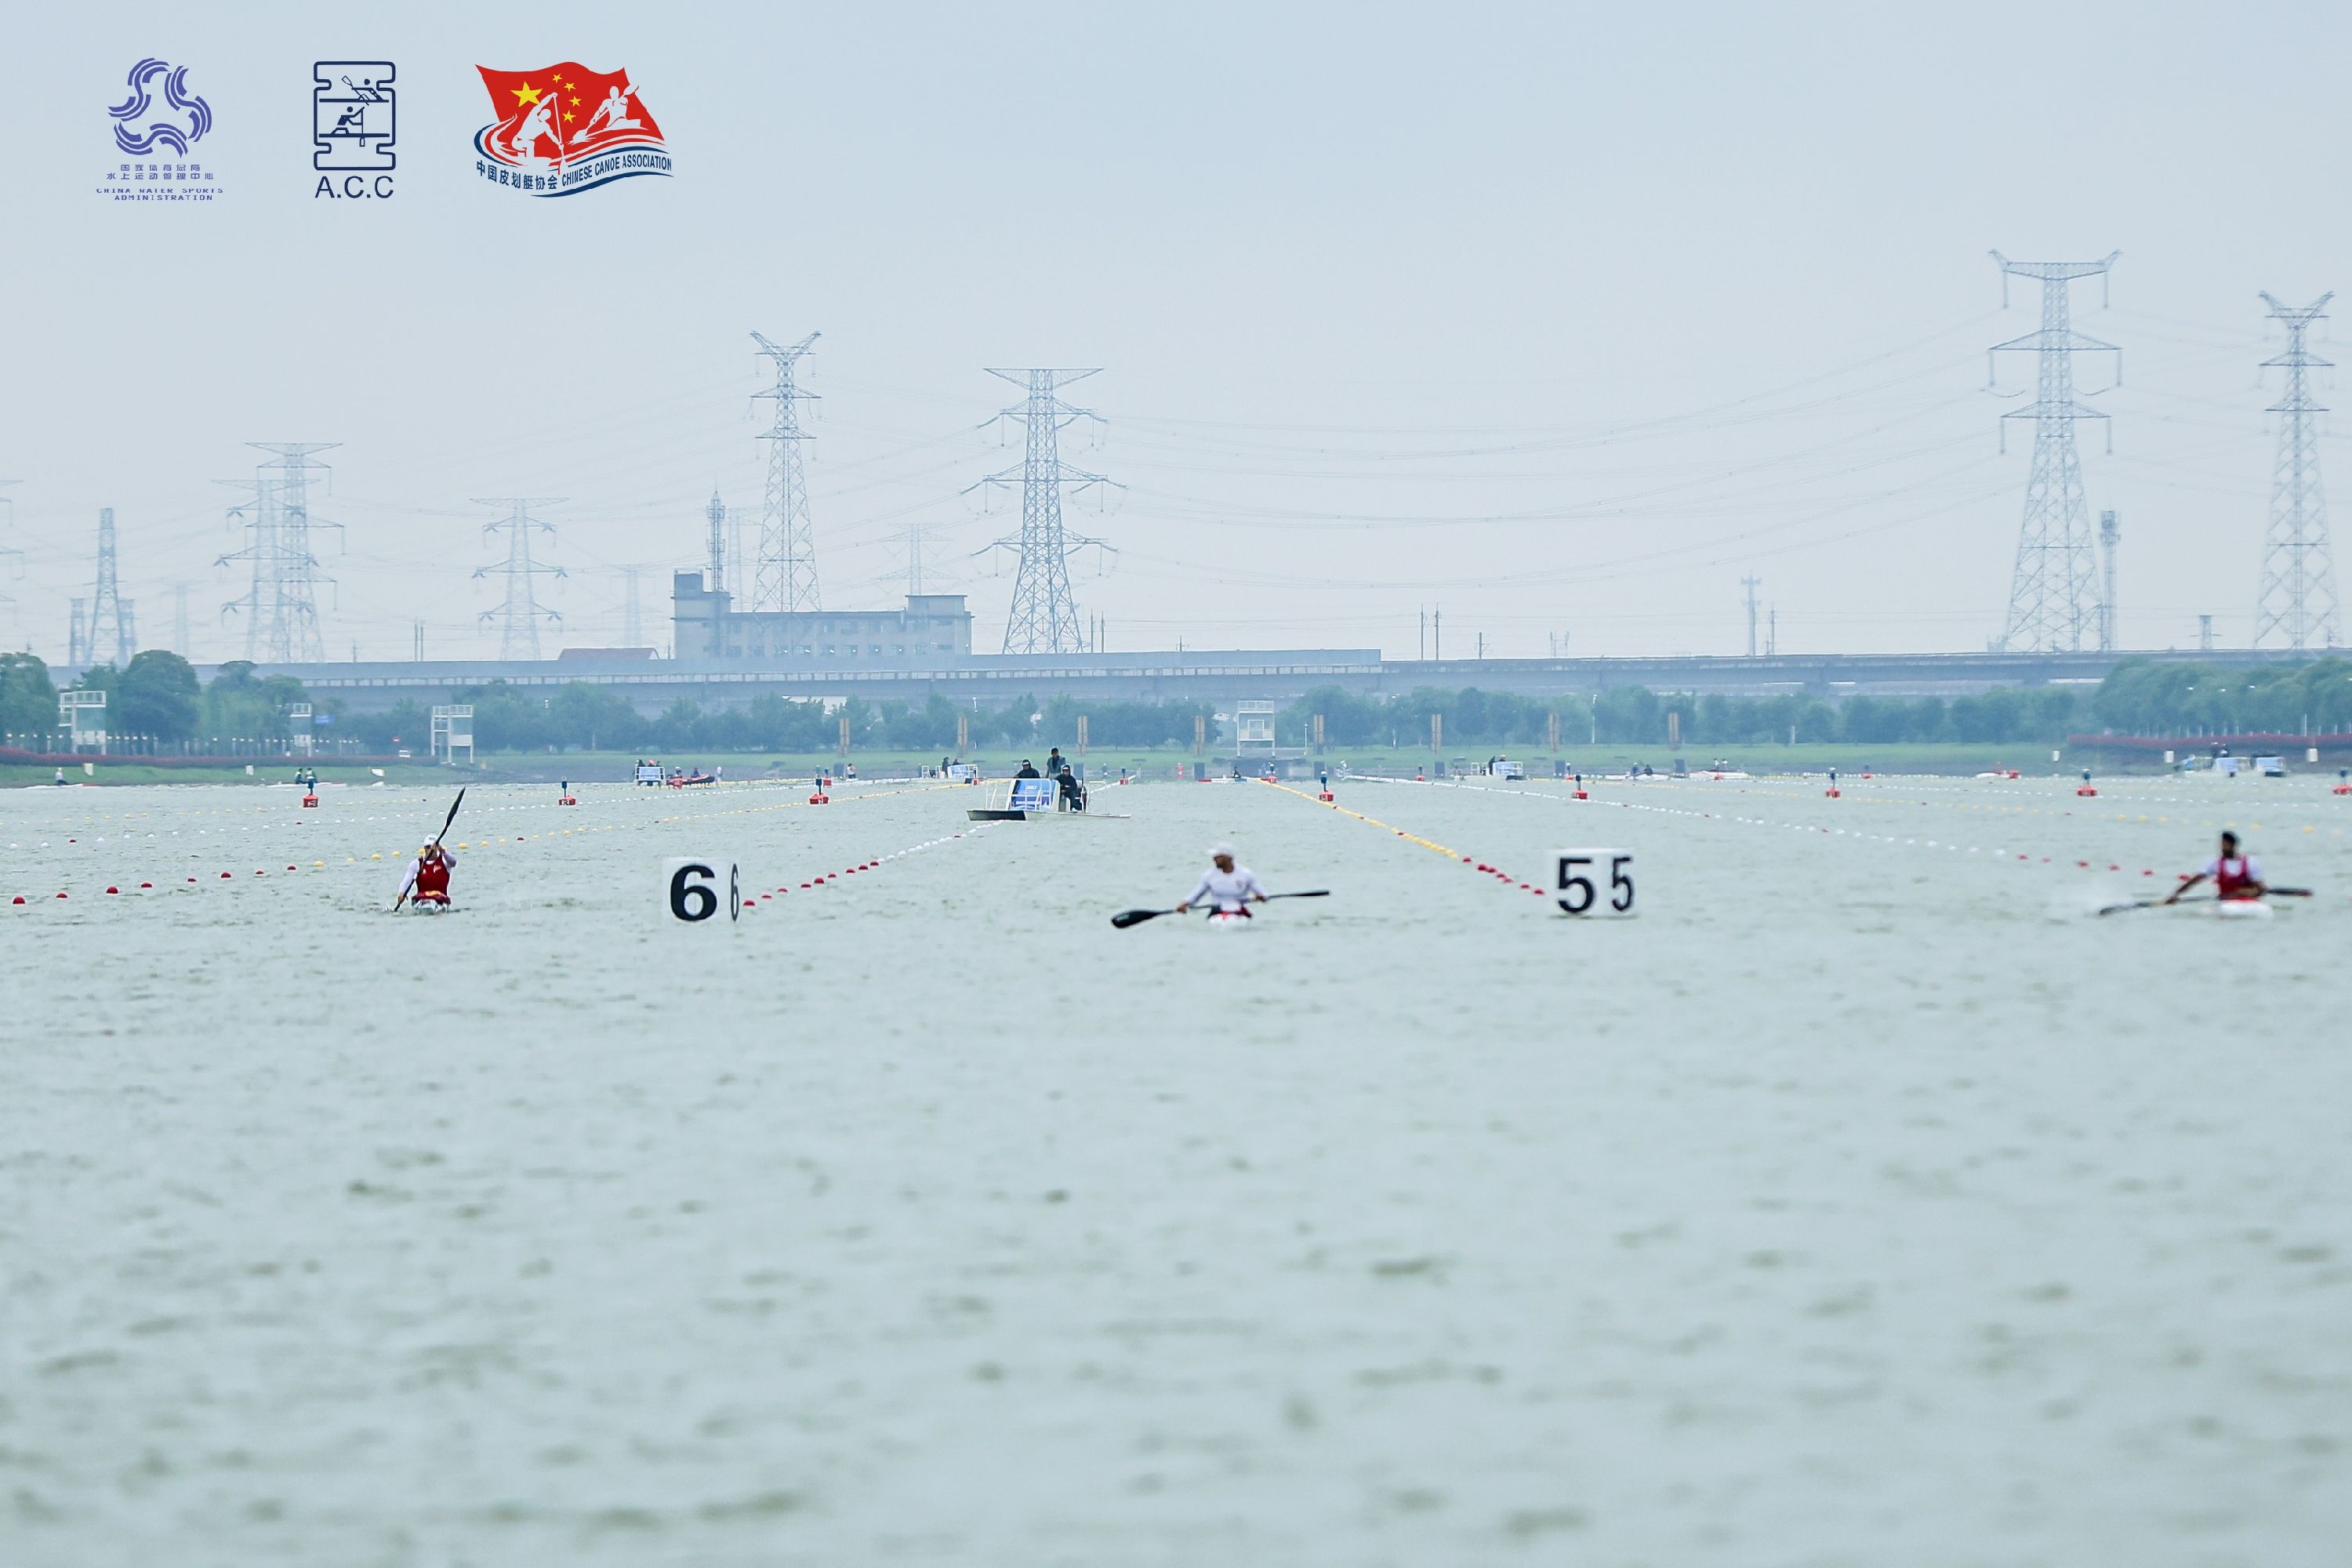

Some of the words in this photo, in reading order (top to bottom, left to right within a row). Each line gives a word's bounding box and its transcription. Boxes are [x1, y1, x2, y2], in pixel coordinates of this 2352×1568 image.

[670, 864, 717, 921] 6
[731, 863, 739, 921] 6
[1558, 857, 1595, 913] 5
[1611, 856, 1633, 911] 5
